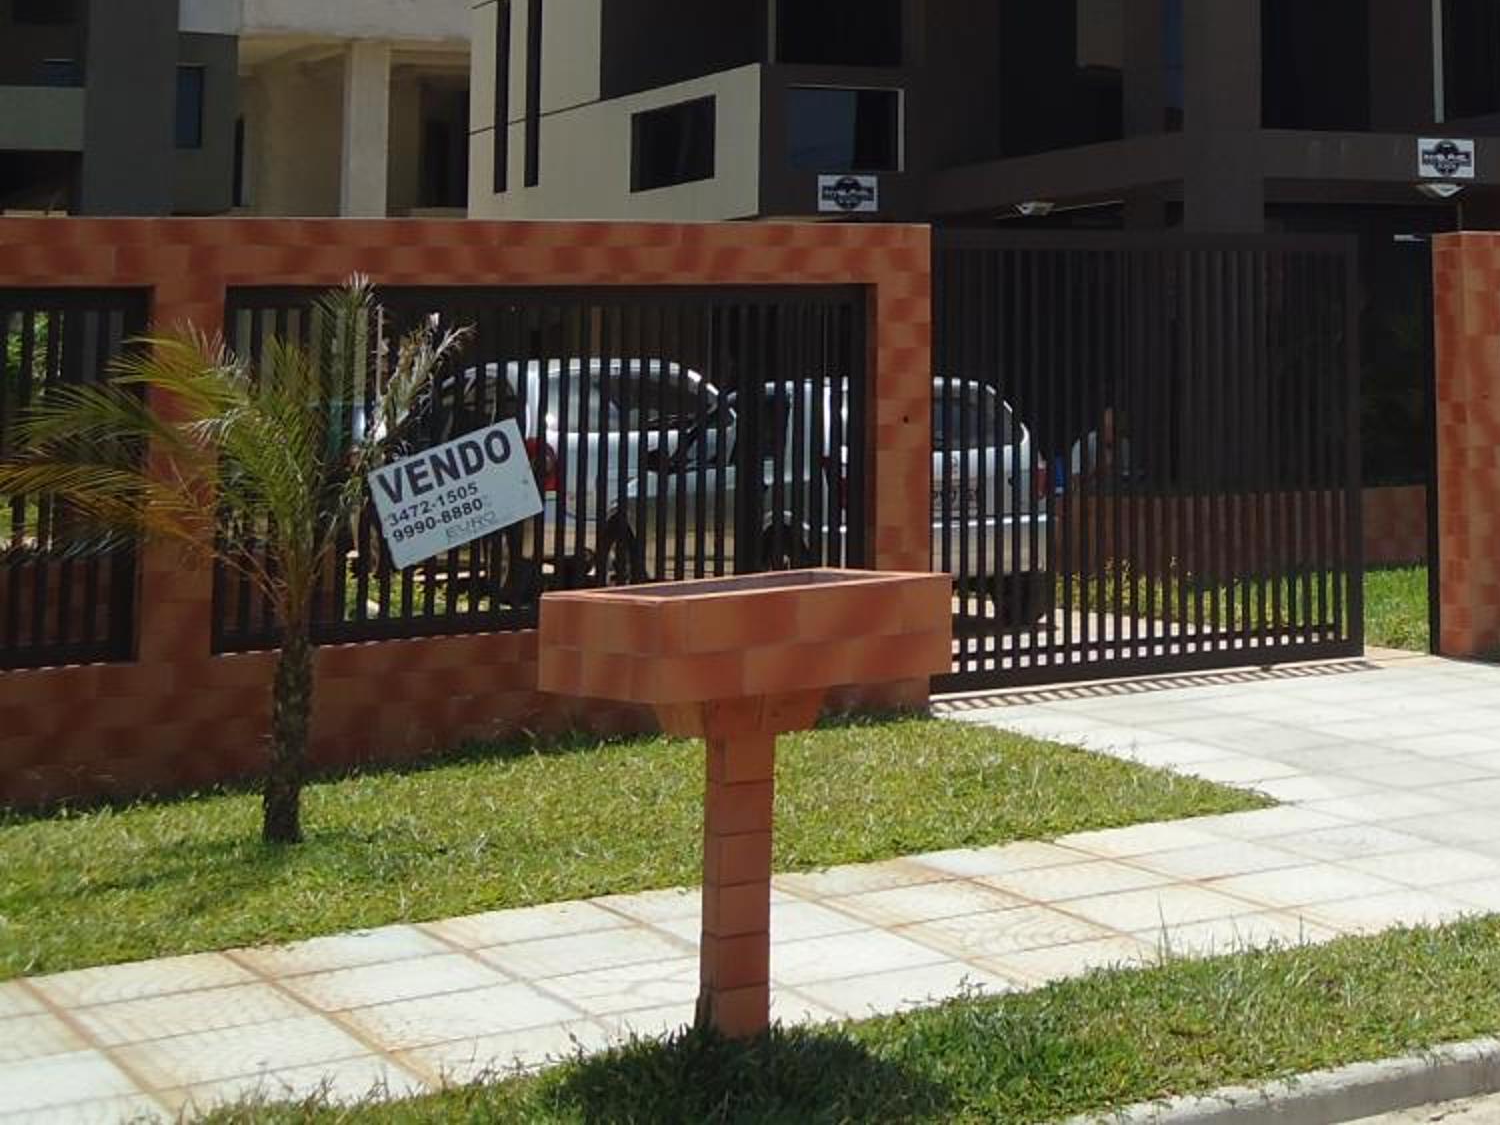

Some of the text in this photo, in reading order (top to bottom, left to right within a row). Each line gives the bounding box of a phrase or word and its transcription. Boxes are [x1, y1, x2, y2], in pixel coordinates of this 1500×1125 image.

[376, 430, 511, 505] VENDO
[389, 482, 478, 527] 3472-1505
[392, 498, 483, 543] 9990-8880
